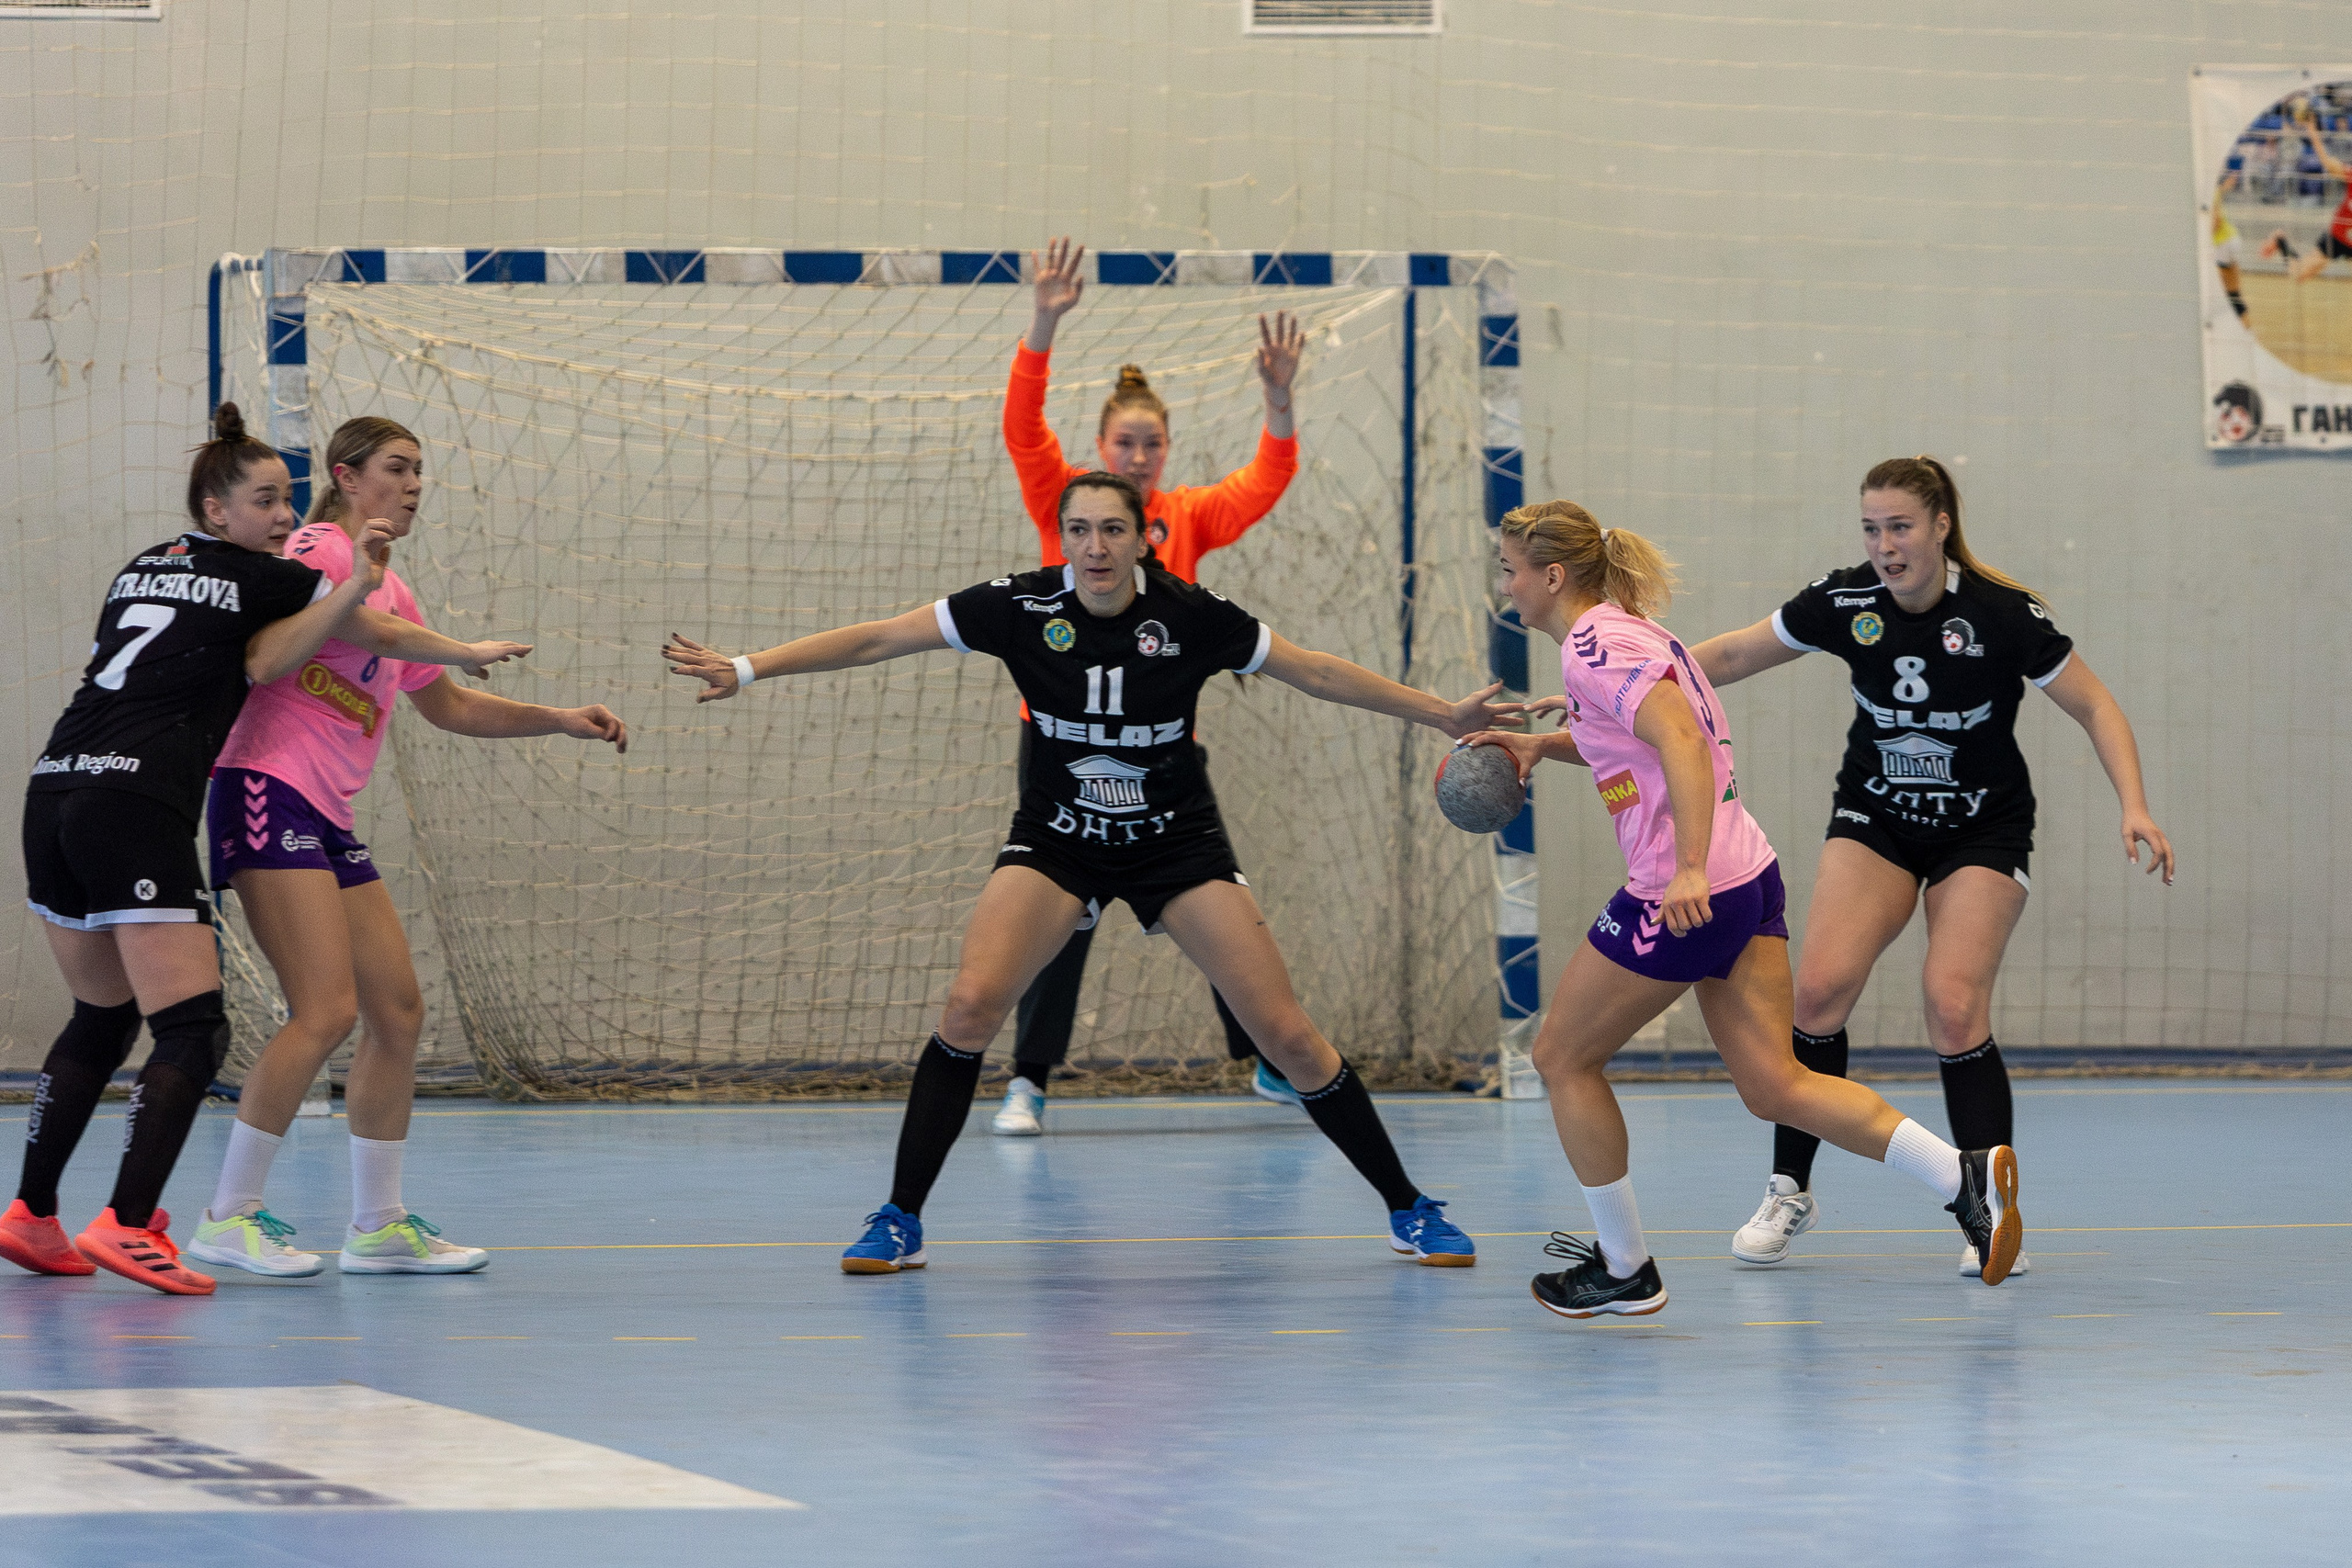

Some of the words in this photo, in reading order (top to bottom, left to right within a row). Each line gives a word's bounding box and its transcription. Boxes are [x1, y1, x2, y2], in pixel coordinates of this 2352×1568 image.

[1023, 600, 1064, 615] Kempa
[1834, 596, 1876, 608] Kempa
[94, 604, 176, 691] 7
[1083, 665, 1125, 716] 11
[1893, 656, 1929, 703] 8
[74, 750, 141, 774] Region
